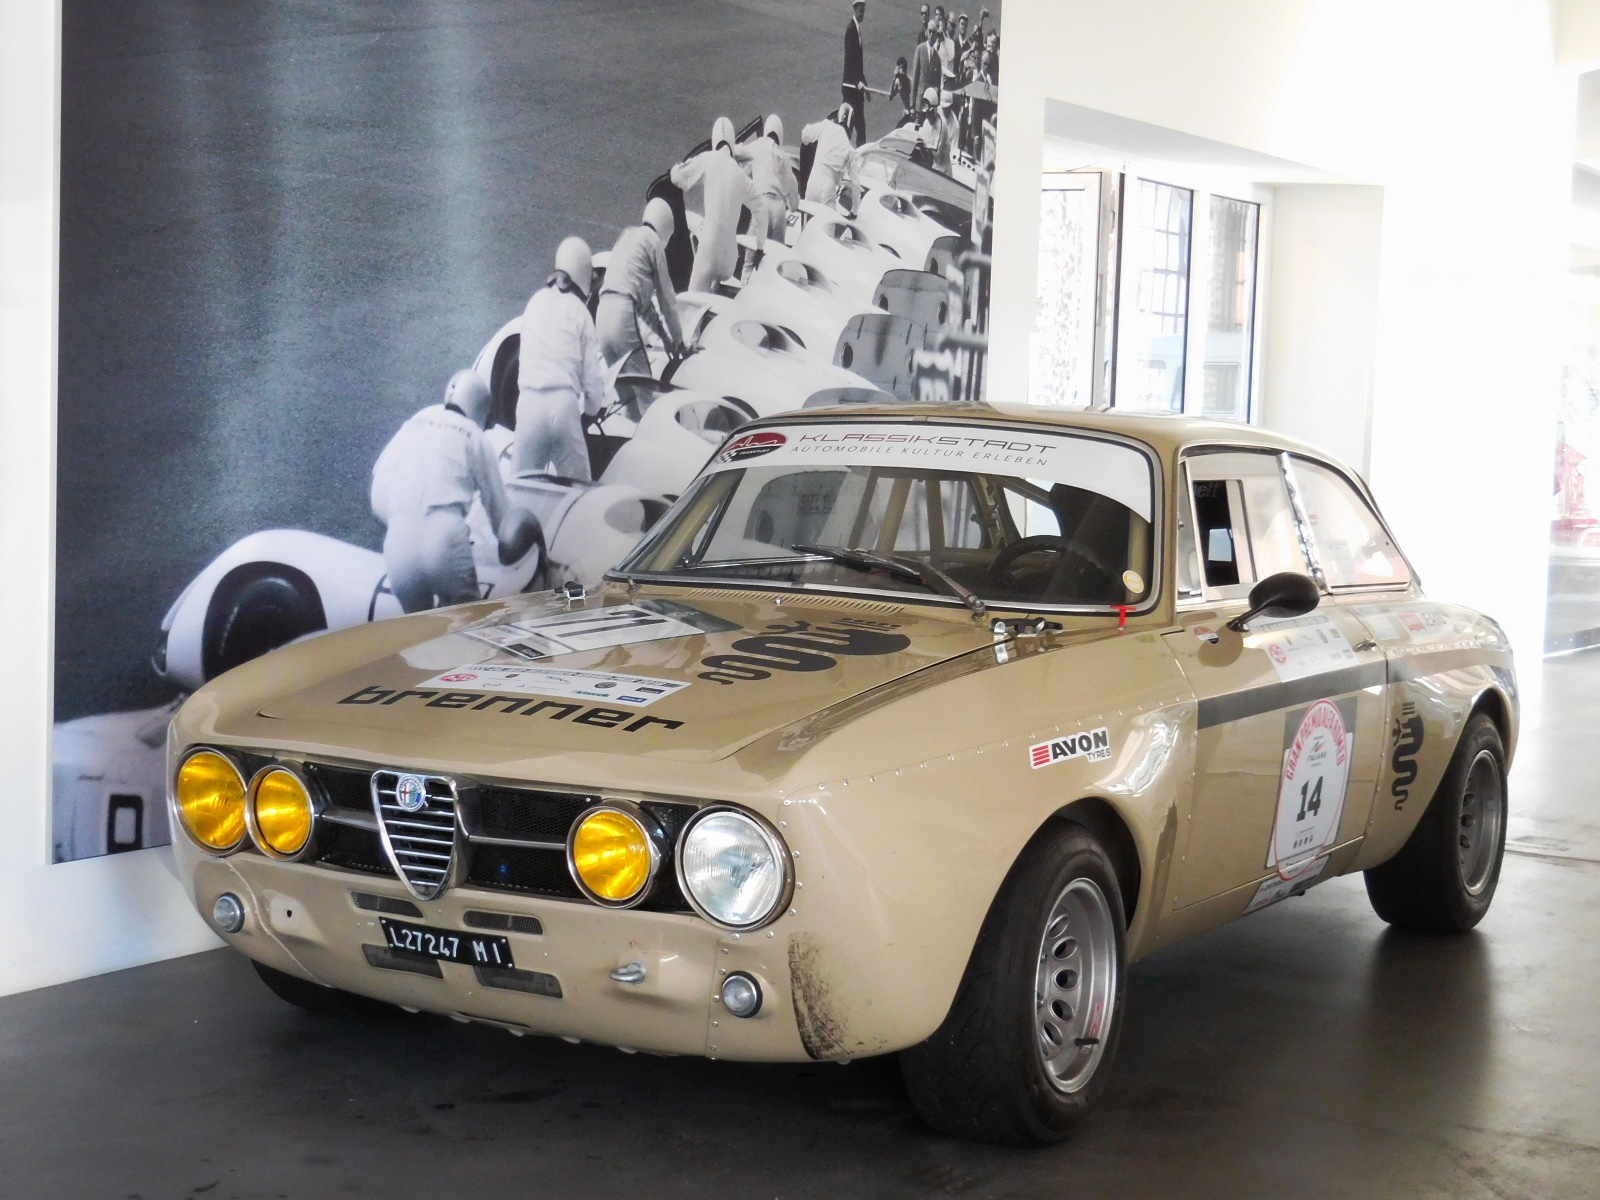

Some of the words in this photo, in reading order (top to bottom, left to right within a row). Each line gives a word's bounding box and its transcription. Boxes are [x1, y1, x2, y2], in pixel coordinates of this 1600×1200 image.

[790, 445, 894, 454] AUTOMOBILE
[901, 447, 964, 458] KULTUR
[972, 451, 1048, 466] ERLEBEN
[799, 433, 1057, 454] KLASSIKSTADT
[336, 685, 685, 733] brenner
[1051, 730, 1108, 760] AVON
[1087, 748, 1111, 761] TYRES
[1285, 741, 1303, 781] GRAN
[1296, 776, 1323, 822] 14
[389, 927, 460, 958] L27247
